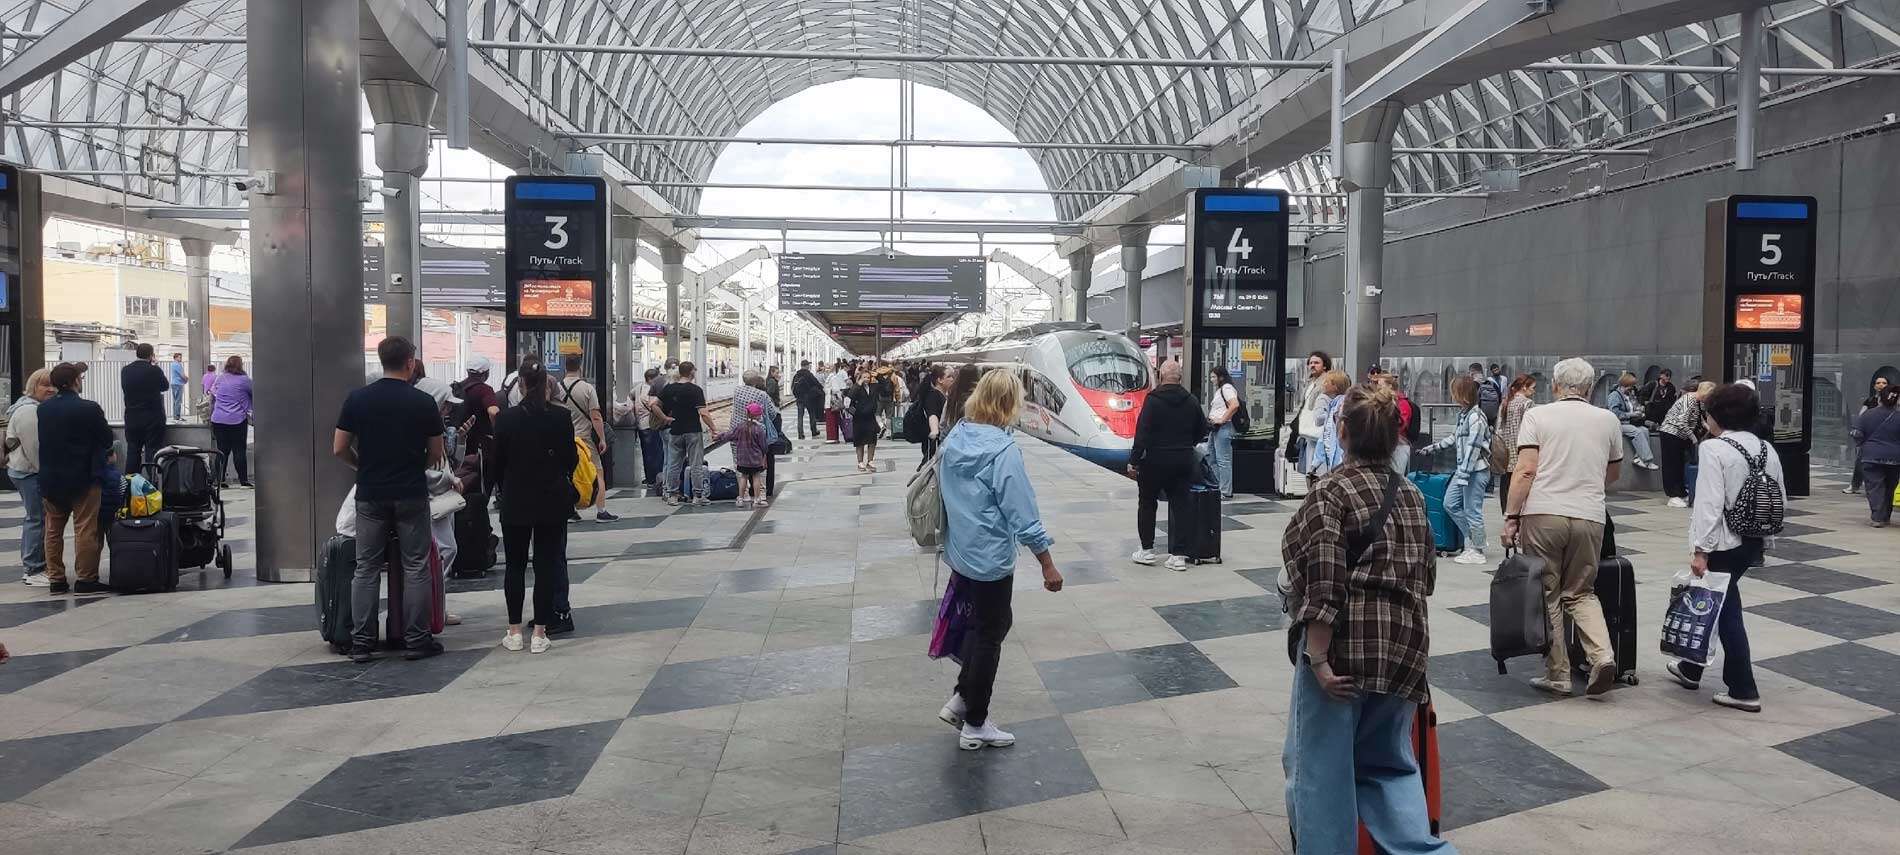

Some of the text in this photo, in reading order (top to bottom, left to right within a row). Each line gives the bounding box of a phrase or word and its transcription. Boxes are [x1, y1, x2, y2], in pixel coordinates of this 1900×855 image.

[543, 216, 569, 250] 3
[1227, 227, 1253, 260] 4
[1760, 233, 1782, 266] 5
